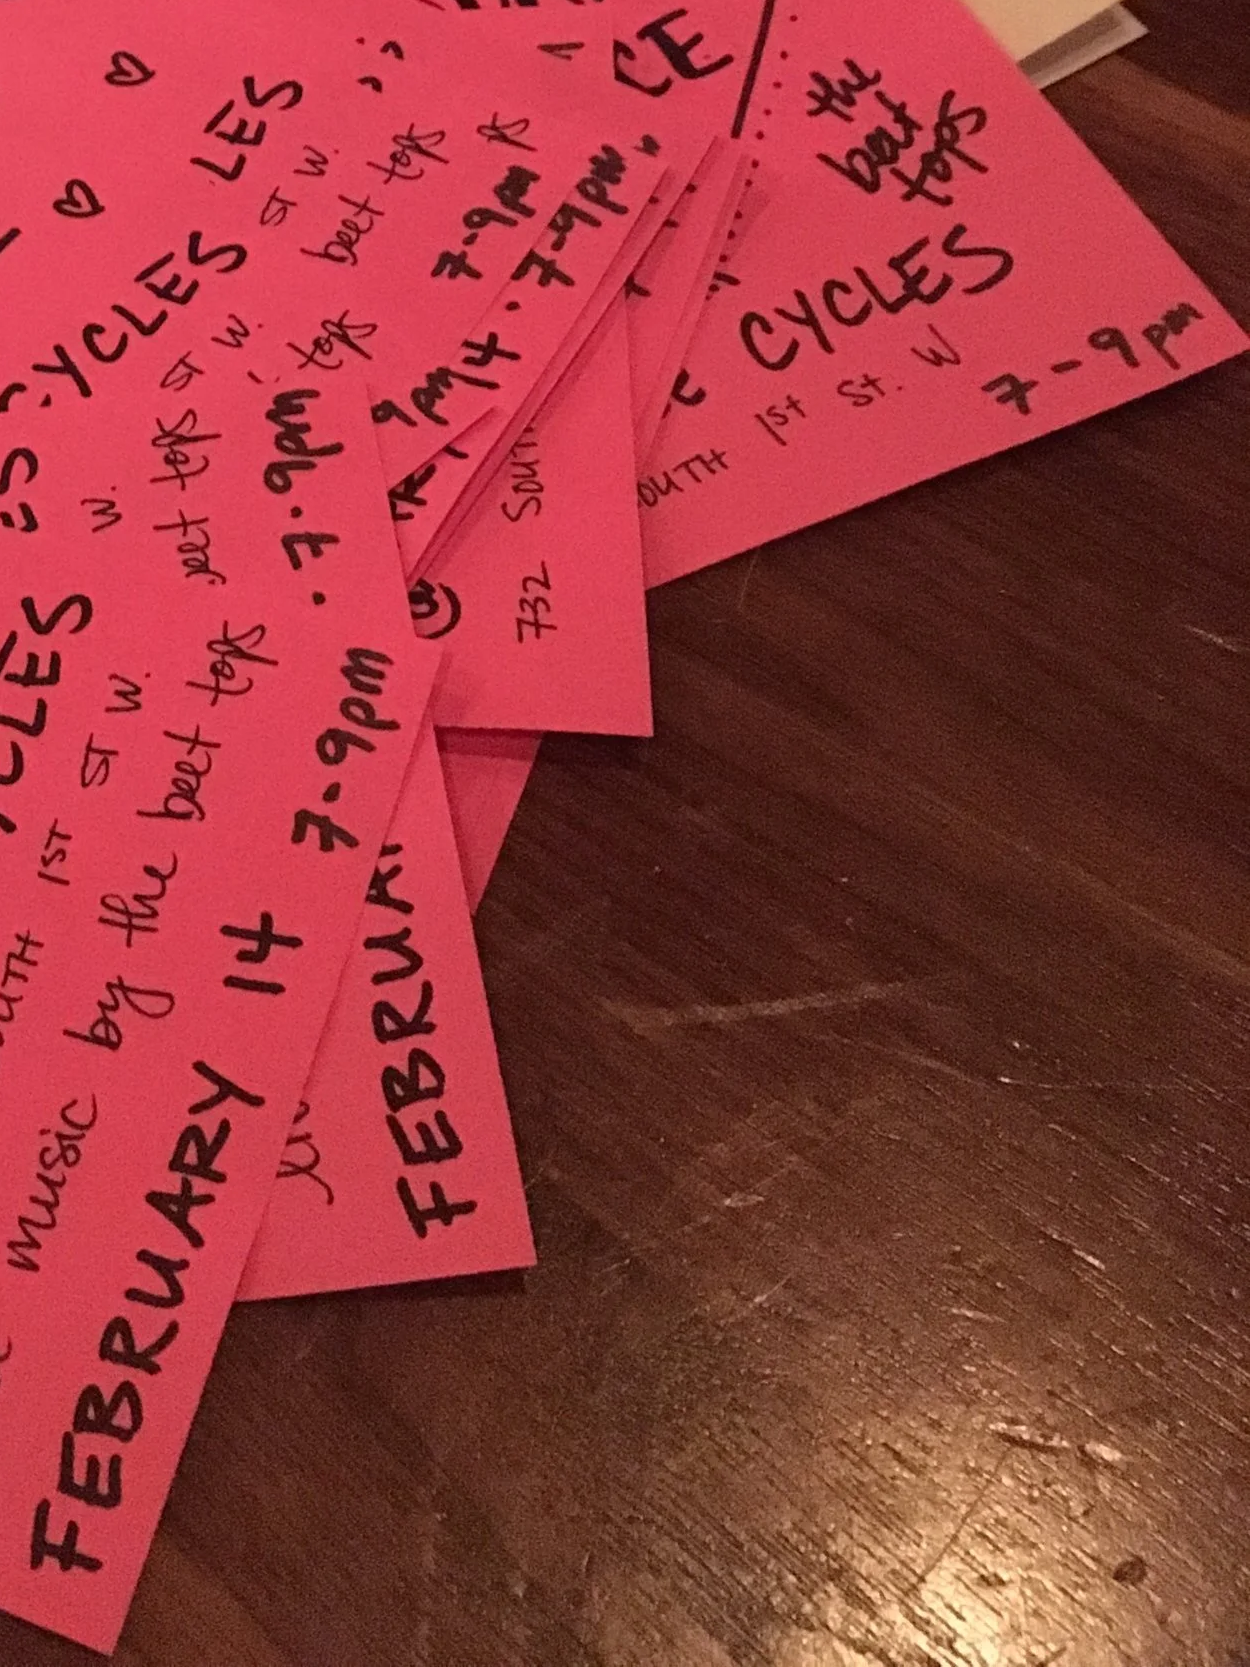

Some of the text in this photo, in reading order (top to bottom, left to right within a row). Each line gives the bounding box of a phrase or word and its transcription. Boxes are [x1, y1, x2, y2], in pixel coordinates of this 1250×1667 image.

[190, 75, 304, 182] LES
[806, 57, 882, 122] the
[259, 186, 298, 226] ST
[738, 223, 1015, 373] CYCLES
[159, 350, 205, 392] ST
[637, 447, 730, 509] OUTH
[911, 323, 963, 368] W
[502, 426, 558, 644] 732 SOUT
[185, 619, 280, 707] tops
[37, 817, 73, 887] 1ST
[81, 730, 120, 789] ST
[97, 851, 179, 948] the
[63, 974, 176, 1052] by
[6, 1093, 98, 1273] music
[29, 1059, 267, 1573] FEBRUARY
[219, 911, 304, 996] 14
